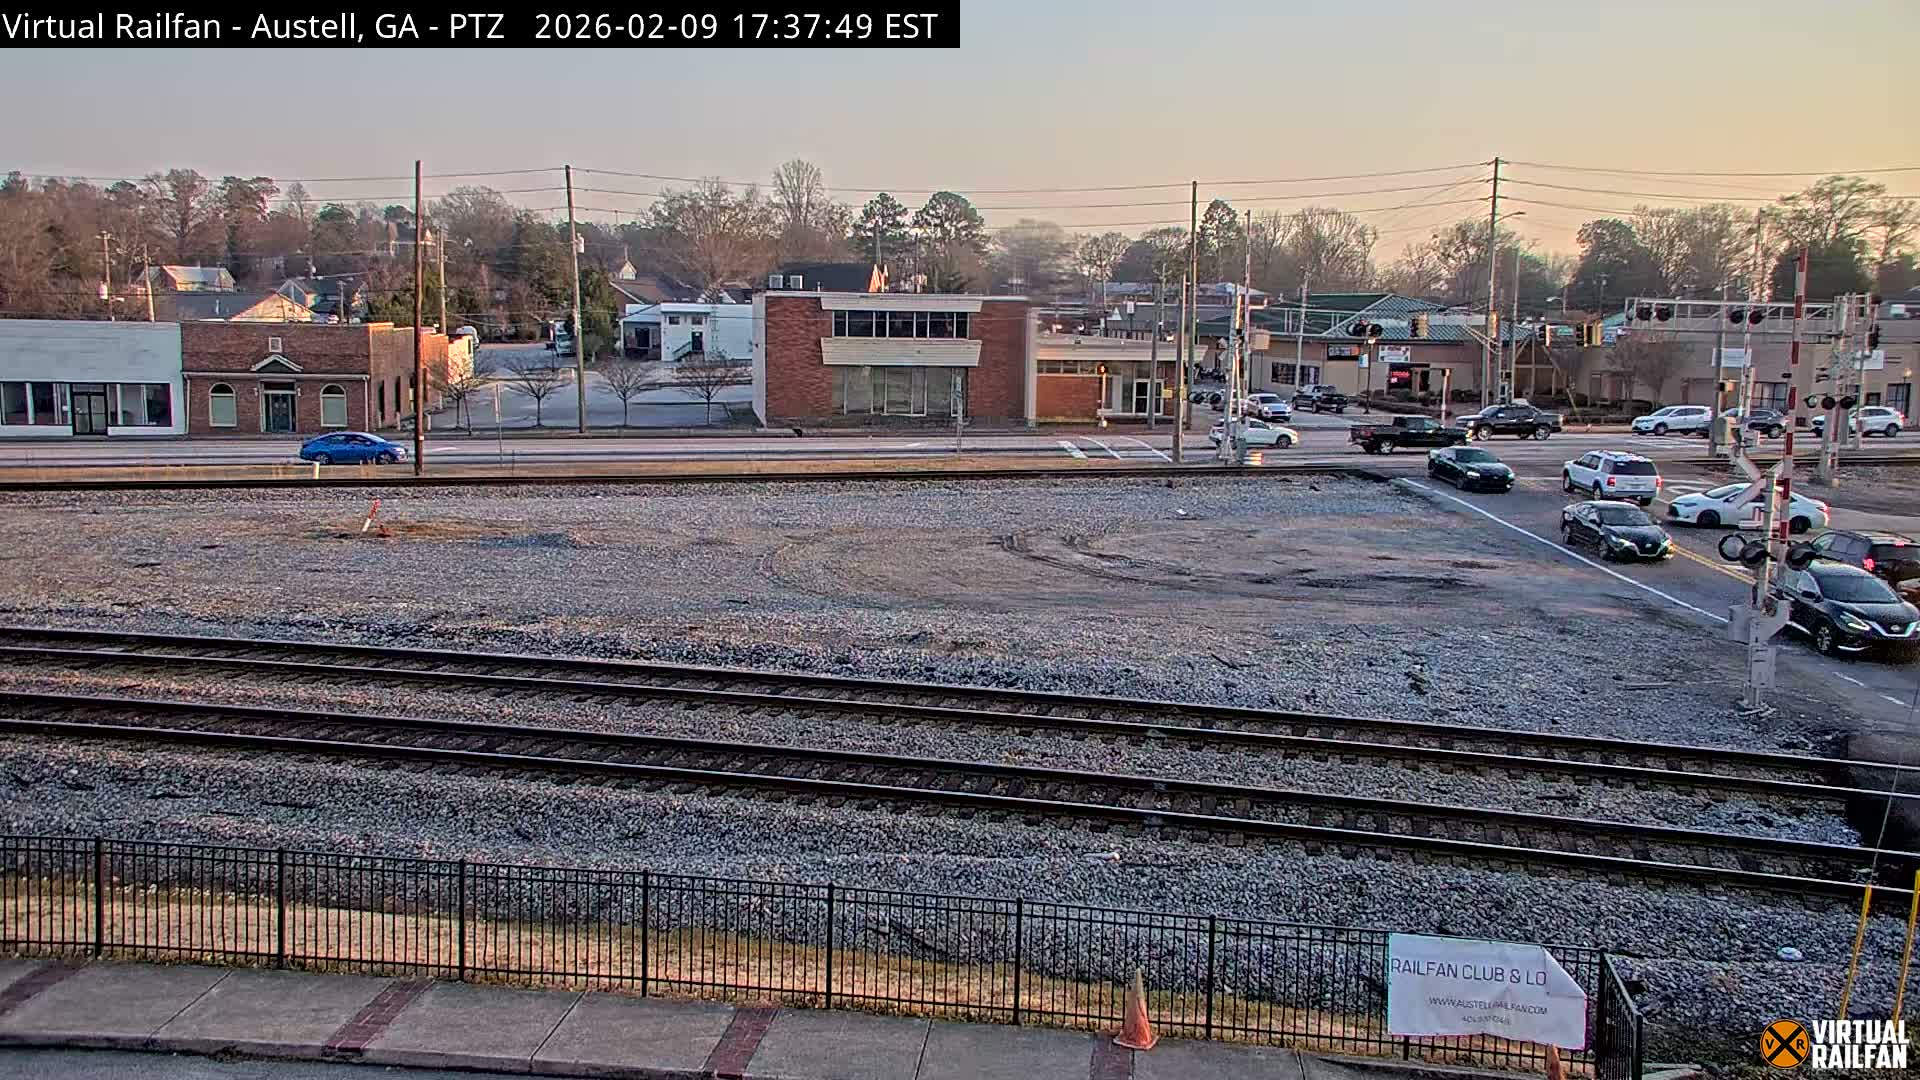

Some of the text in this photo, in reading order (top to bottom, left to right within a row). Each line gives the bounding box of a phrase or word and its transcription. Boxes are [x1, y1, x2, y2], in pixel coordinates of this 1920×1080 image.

[1391, 959, 1457, 979] RAILFAN
[1462, 964, 1505, 982] CLUB
[1509, 968, 1521, 984] &
